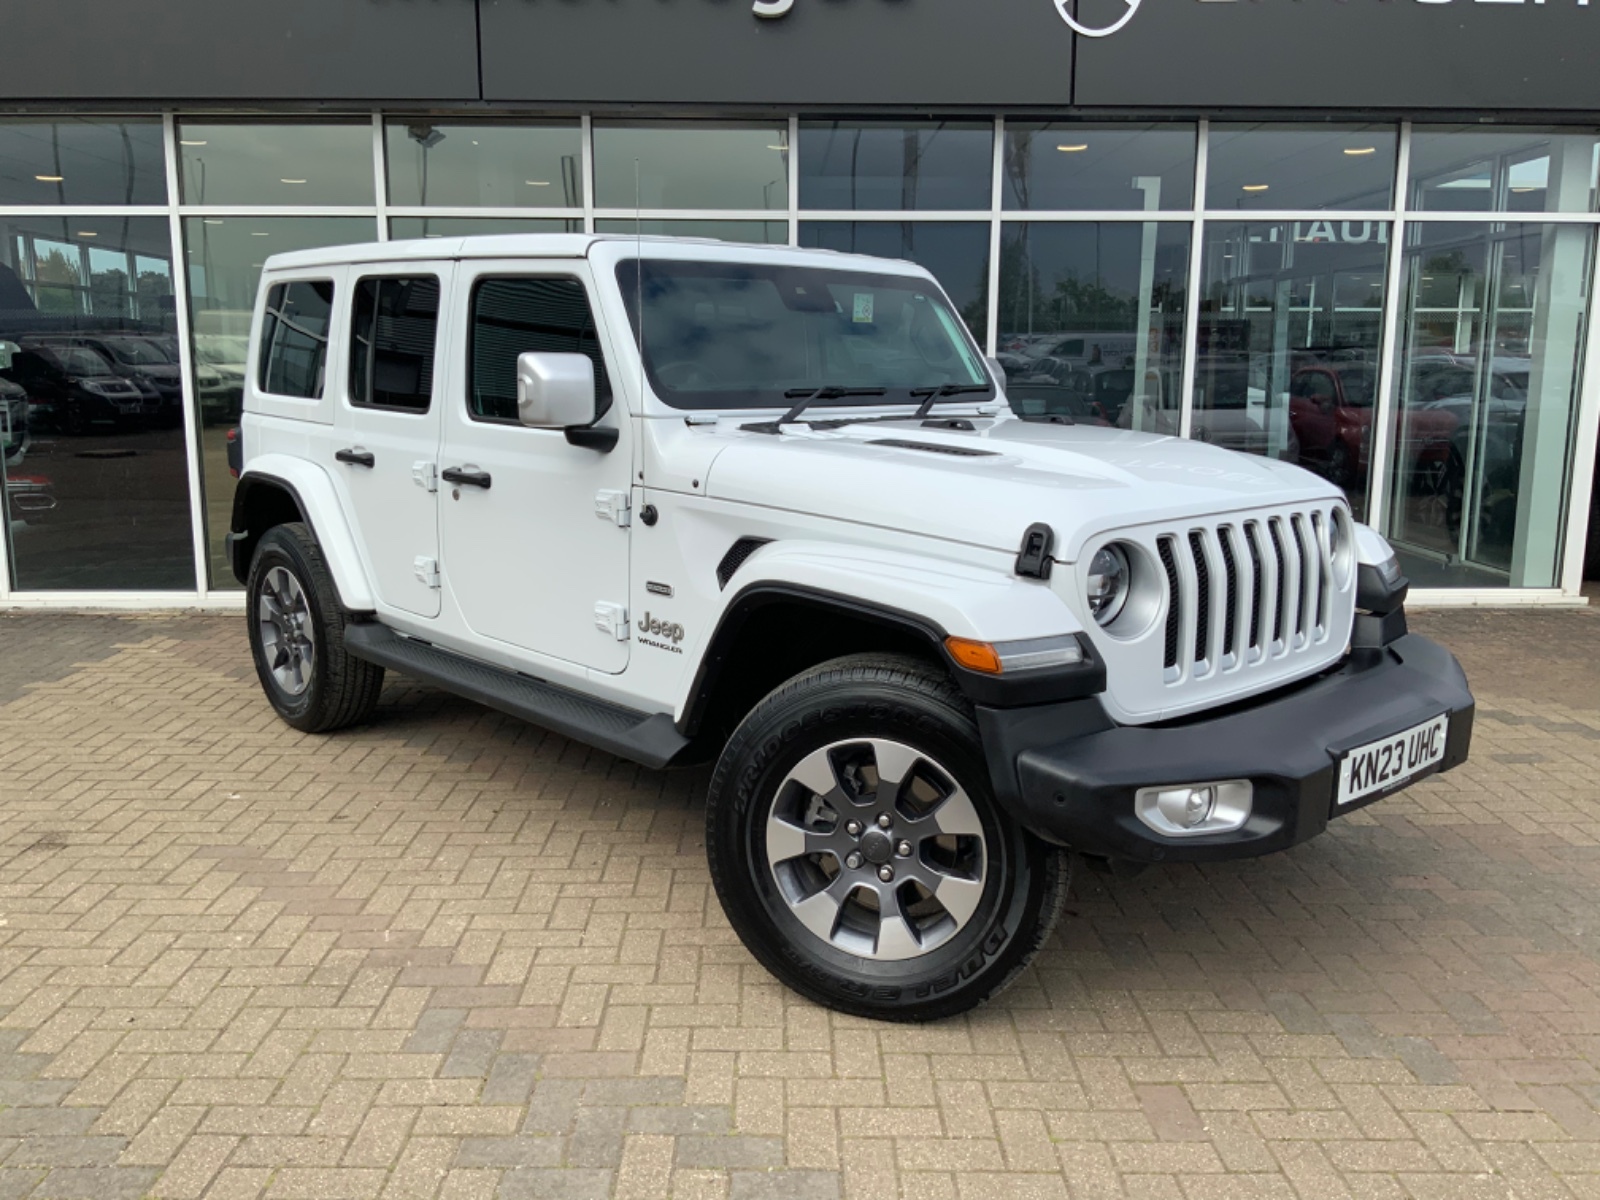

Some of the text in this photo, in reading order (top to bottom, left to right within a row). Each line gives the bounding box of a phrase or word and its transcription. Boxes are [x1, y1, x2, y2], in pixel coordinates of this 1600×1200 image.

[638, 611, 684, 644] Jeep
[638, 636, 683, 654] WRANGLER
[1349, 723, 1441, 794] KN23 UHC
